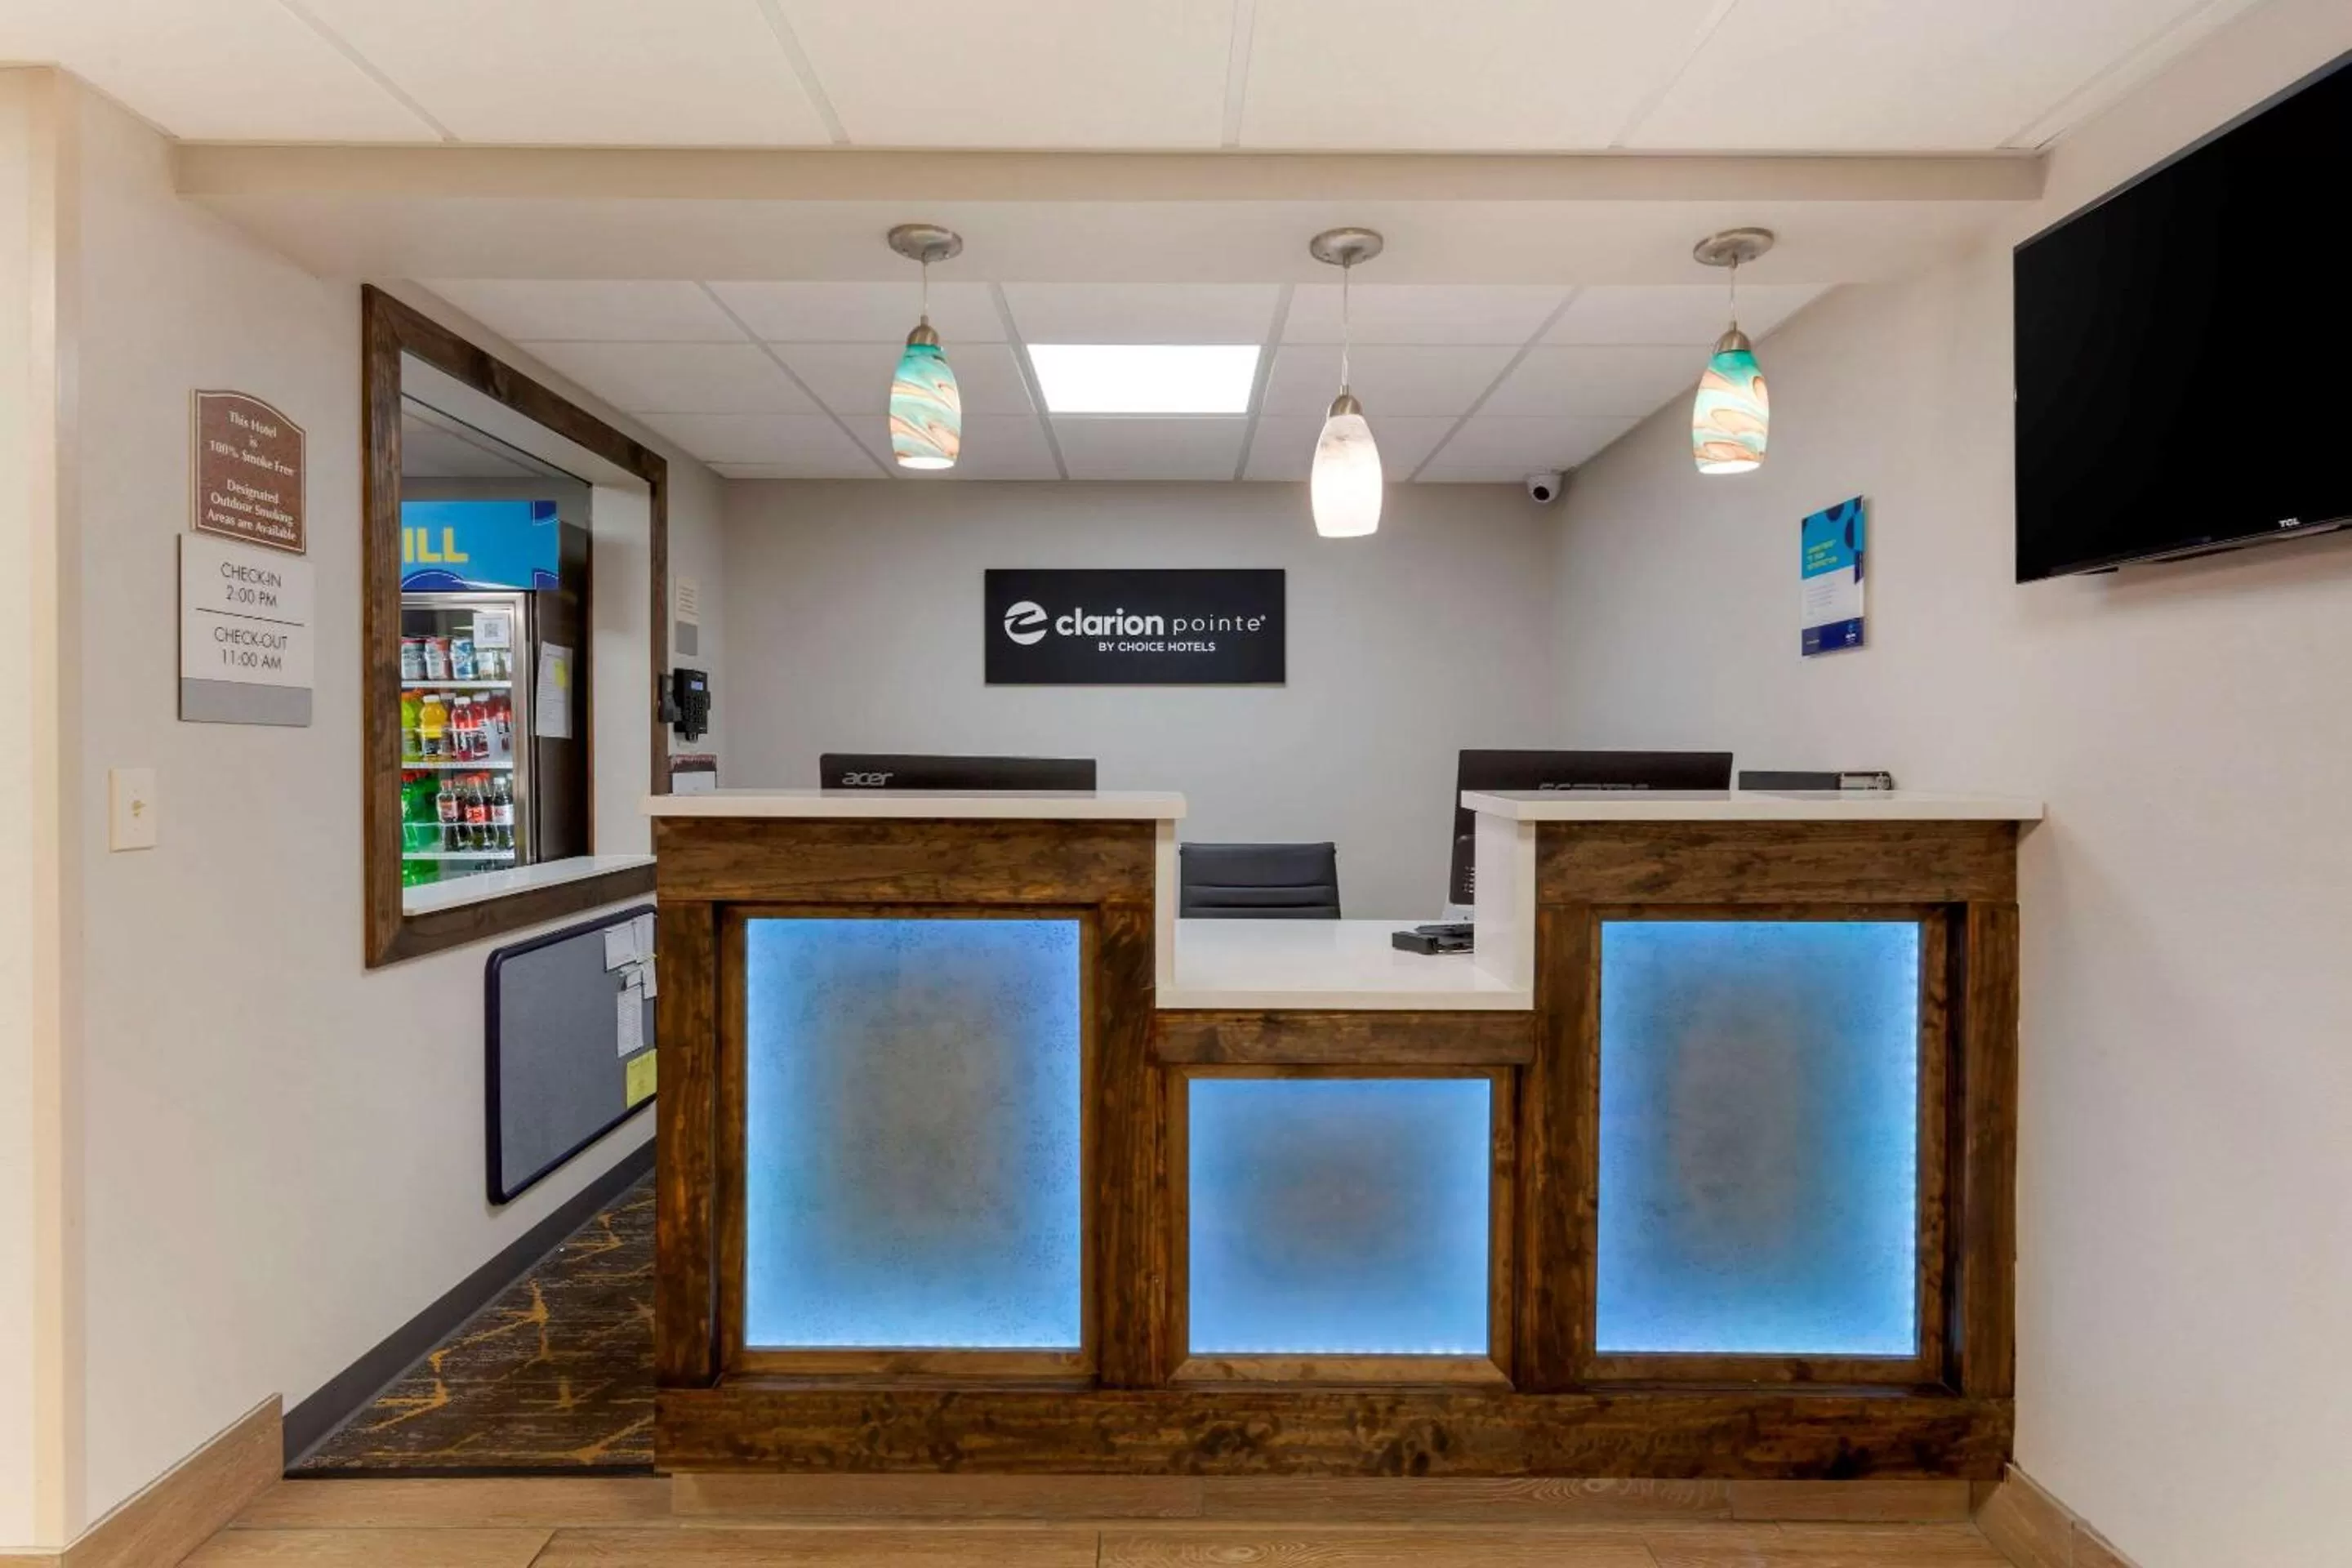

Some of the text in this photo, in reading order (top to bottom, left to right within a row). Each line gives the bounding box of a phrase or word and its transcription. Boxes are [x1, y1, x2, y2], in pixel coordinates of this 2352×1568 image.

[229, 410, 277, 439] This Hotel
[249, 435, 258, 448] is
[210, 439, 295, 477] 100% Smoke Free
[227, 479, 279, 504] Designated
[211, 492, 294, 528] Outdoor Smoking
[207, 508, 297, 541] Areas are Available
[2278, 518, 2300, 528] TCL
[220, 562, 282, 588] CHECK-IN
[225, 584, 278, 608] 2:00 PM
[1055, 607, 1262, 636] clarion pointe
[214, 626, 288, 651] CHECK-OUT
[1098, 642, 1216, 652] BY CHOICE HOTELS
[222, 649, 282, 672] 11:00 AM
[842, 772, 893, 786] acer
